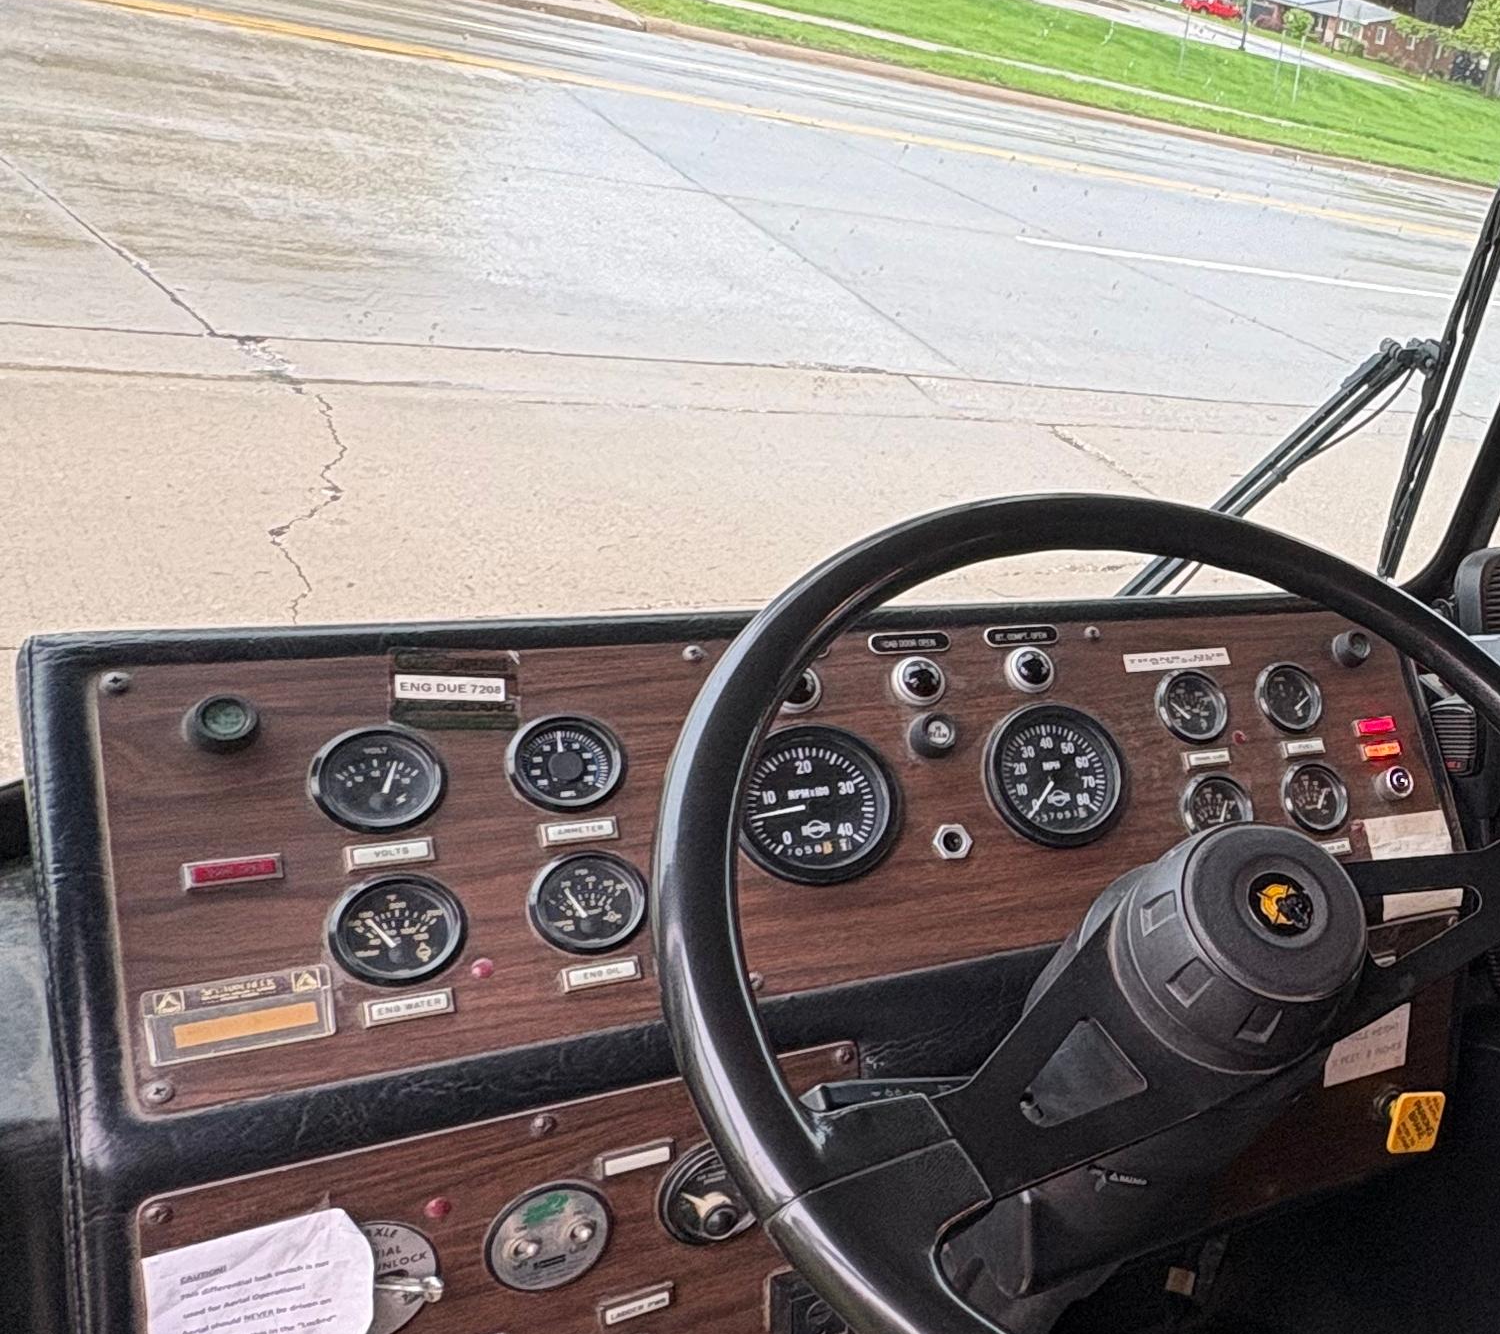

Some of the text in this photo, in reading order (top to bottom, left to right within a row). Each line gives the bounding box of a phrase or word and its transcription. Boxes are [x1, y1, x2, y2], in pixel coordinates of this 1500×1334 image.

[400, 682, 502, 695] ENG DUE 7208
[1040, 736, 1053, 749] 40
[1060, 742, 1075, 754] 50
[1020, 745, 1035, 758] 30
[794, 760, 812, 775] 20
[1013, 762, 1027, 775] 20
[1042, 760, 1061, 771] MPH
[1075, 756, 1089, 768] 60
[837, 781, 855, 795] 30
[1081, 776, 1095, 788] 70
[1016, 783, 1028, 795] 10
[762, 790, 776, 805] 10
[1076, 793, 1090, 805] 80
[837, 822, 853, 836] 40
[782, 830, 792, 845] 0
[374, 847, 410, 858] VOLTS
[377, 997, 442, 1016] ENG WATER
[201, 1278, 252, 1295] differential
[210, 1318, 241, 1330] should
[244, 1310, 274, 1322] NEVER
[289, 1301, 318, 1311] driven
